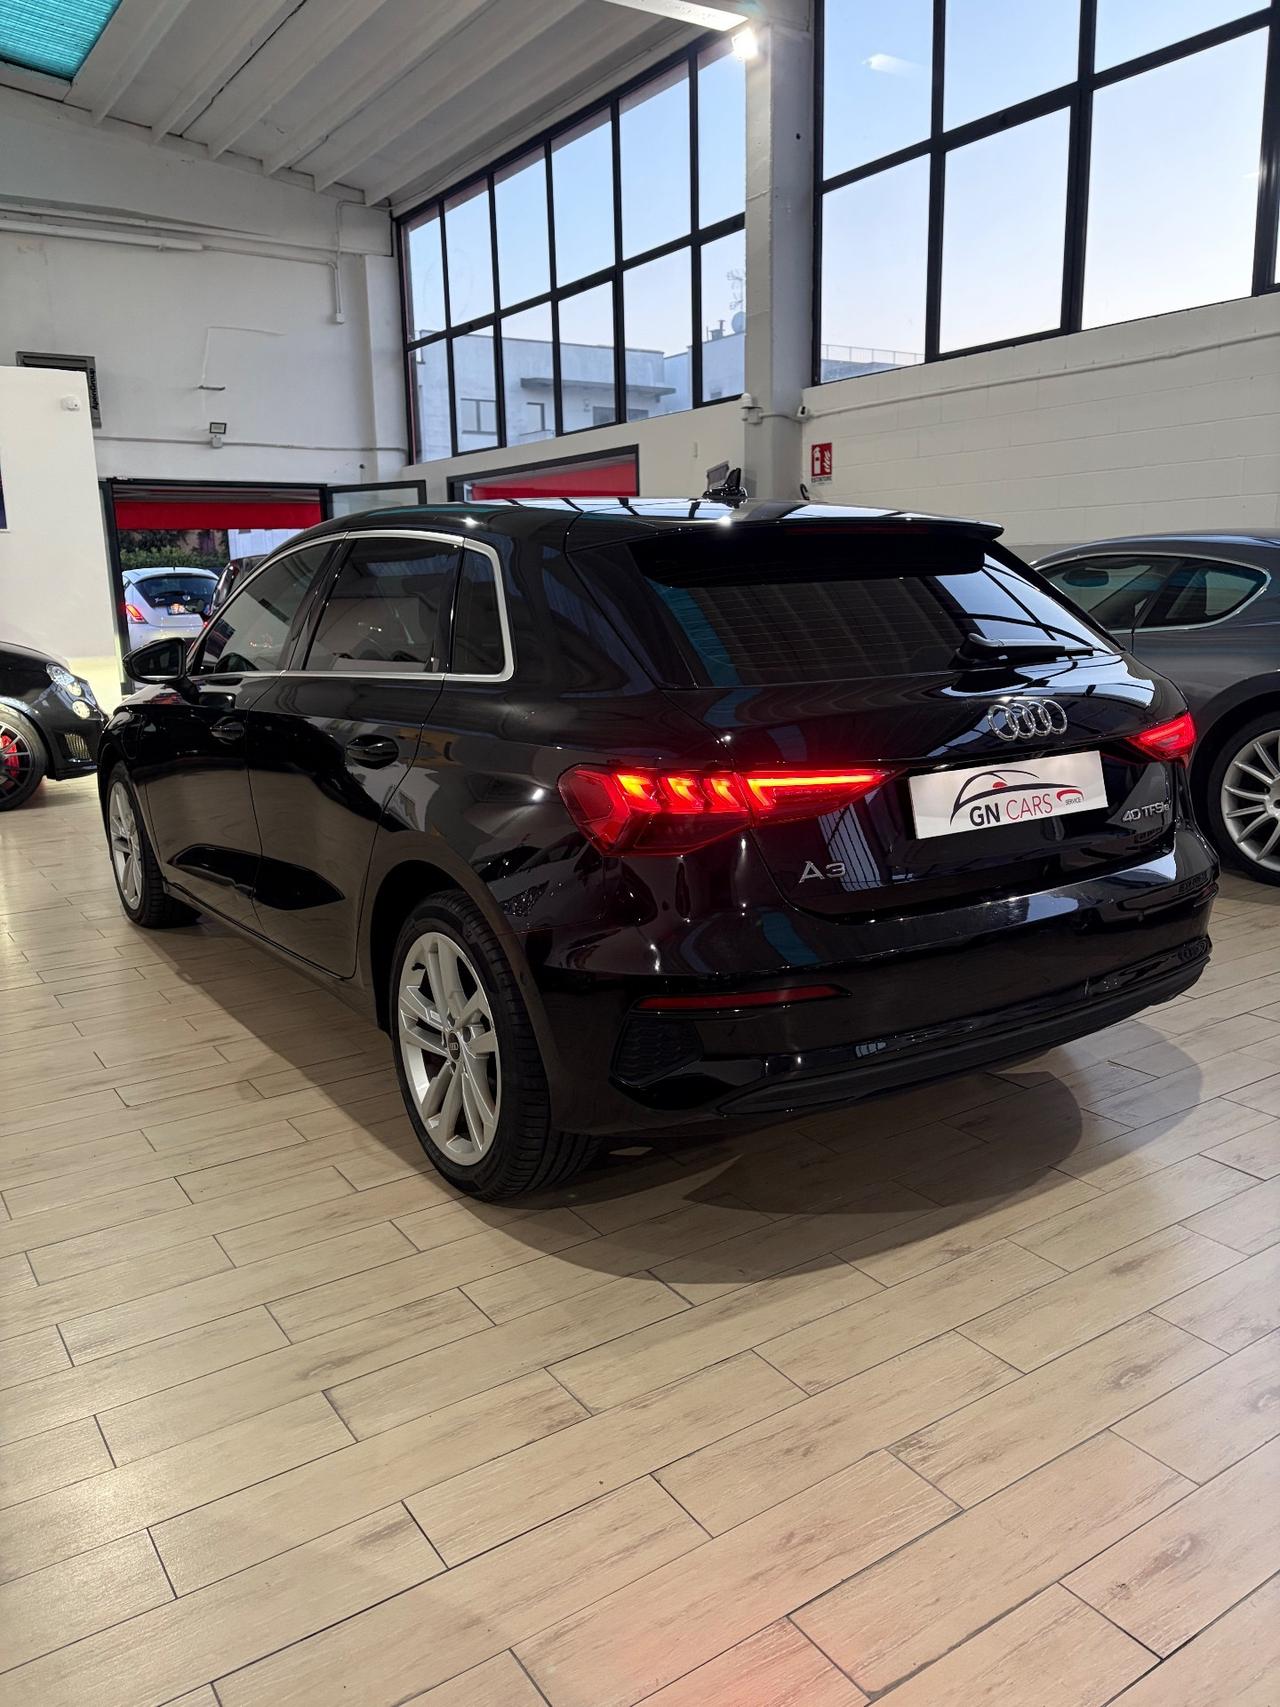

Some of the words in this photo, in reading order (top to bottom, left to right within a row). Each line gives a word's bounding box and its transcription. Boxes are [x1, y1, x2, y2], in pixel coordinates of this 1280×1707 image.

[969, 802, 1001, 827] GN
[1006, 793, 1053, 820] CARS
[1122, 808, 1141, 822] 40
[798, 860, 846, 884] A3
